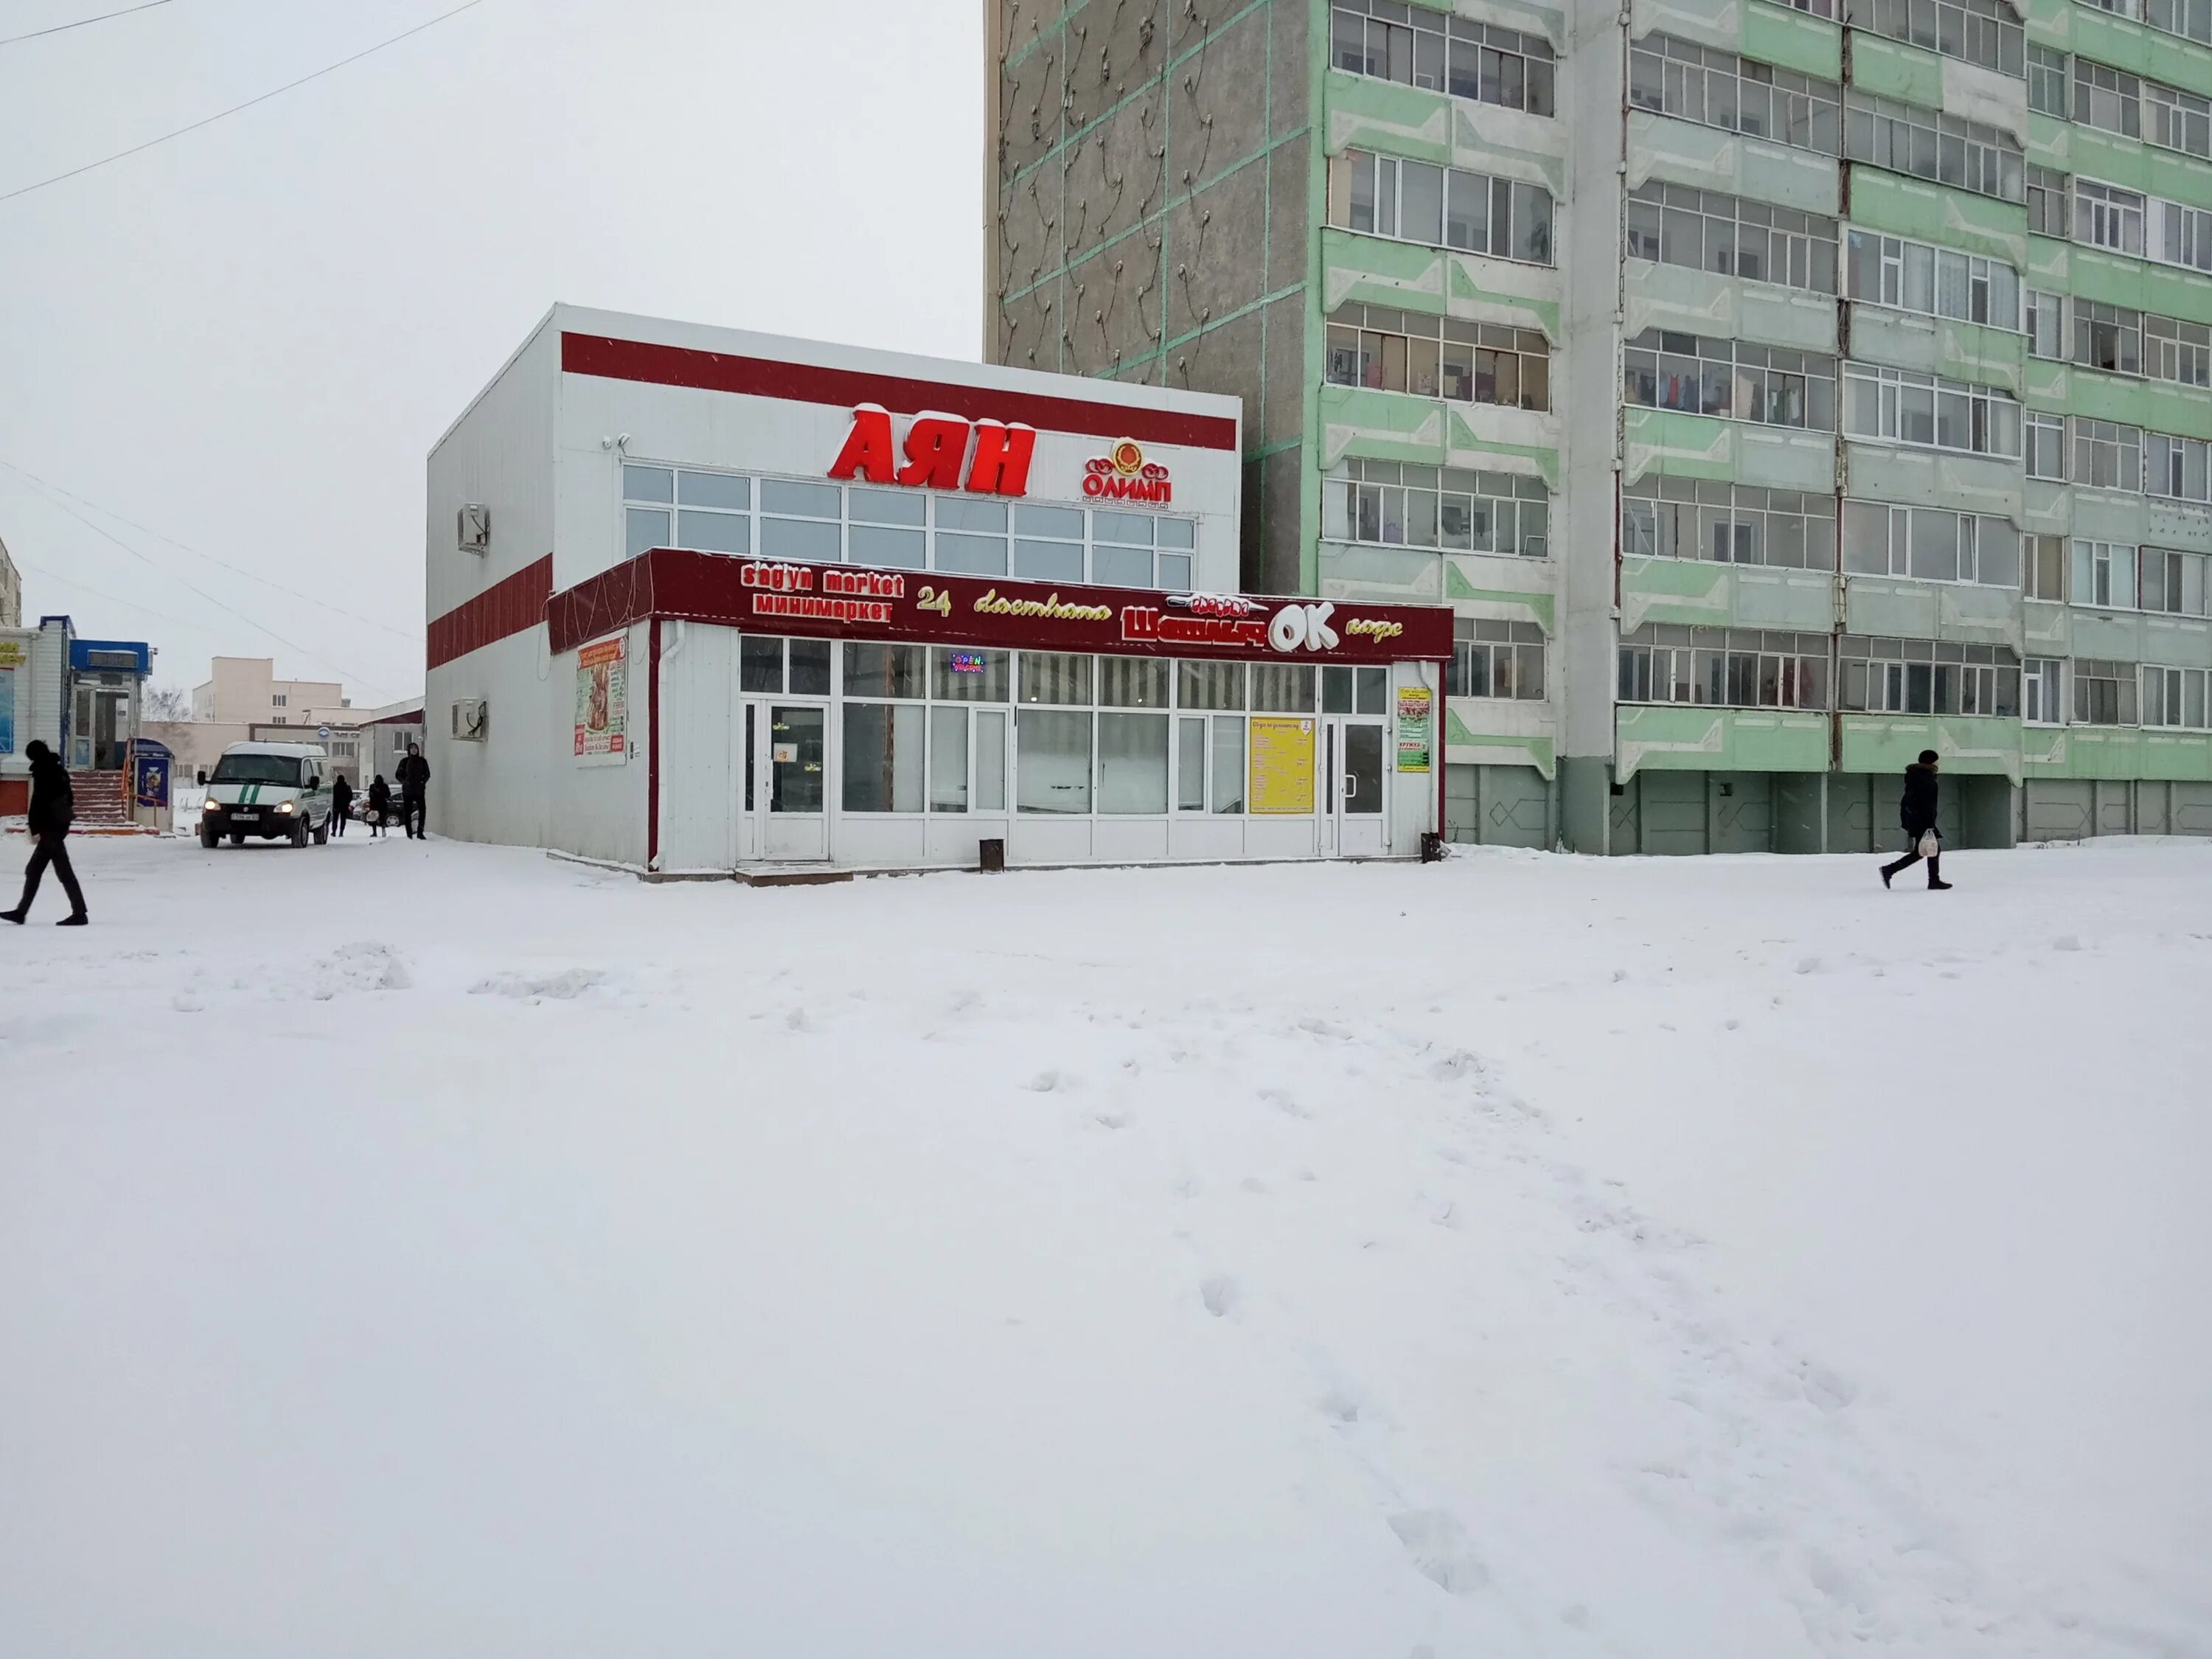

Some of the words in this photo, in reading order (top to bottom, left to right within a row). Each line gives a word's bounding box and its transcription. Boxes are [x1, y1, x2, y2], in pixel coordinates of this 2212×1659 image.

[827, 406, 1036, 496] АЯН
[1082, 473, 1172, 503] ОЛИМП
[824, 571, 904, 598] market
[917, 586, 951, 617] 24
[1346, 618, 1403, 643] кафе
[955, 655, 981, 665] OPEN
